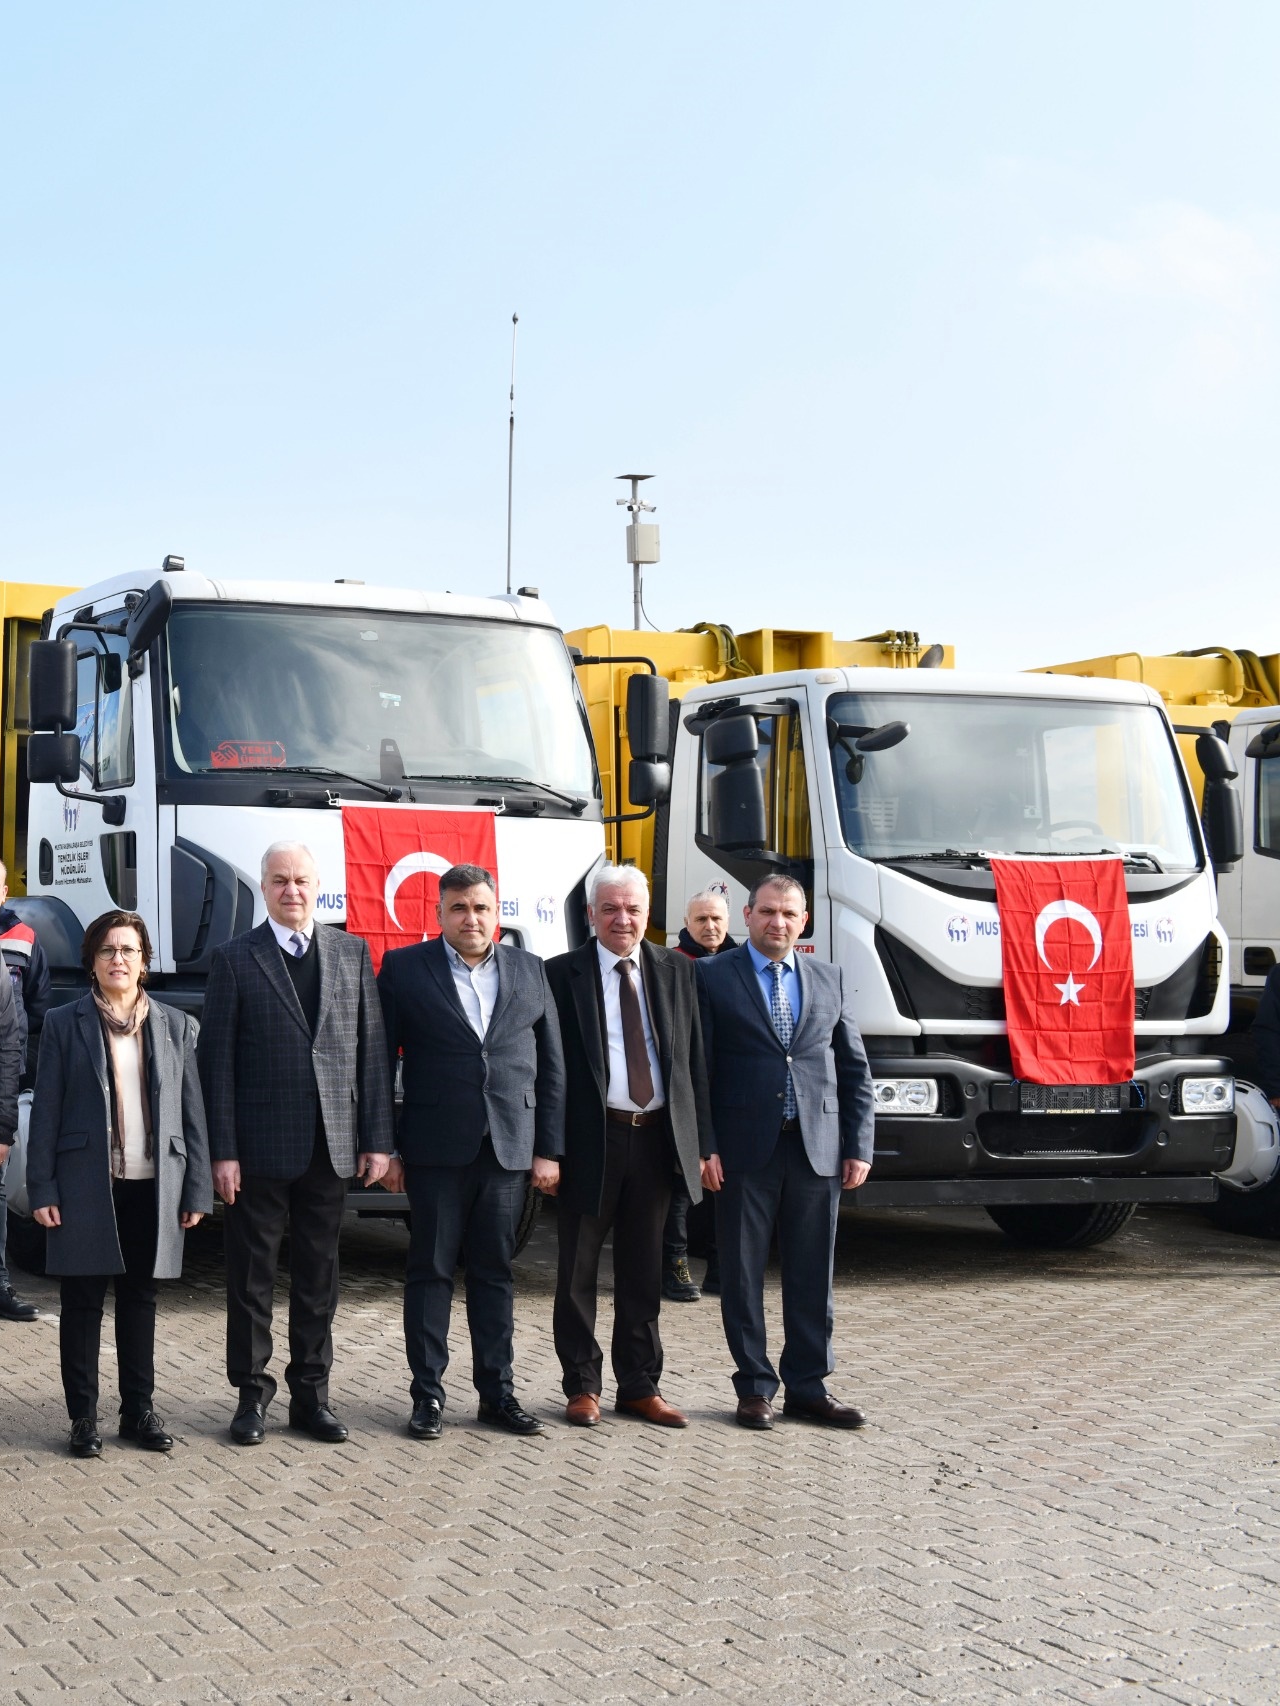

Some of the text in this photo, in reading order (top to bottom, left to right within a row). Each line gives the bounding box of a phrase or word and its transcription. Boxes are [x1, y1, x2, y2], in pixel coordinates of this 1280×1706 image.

[240, 745, 272, 754] YERLİ
[240, 755, 280, 764] ÜRETİM
[57, 851, 76, 863] TEMİZLİK
[60, 862, 86, 875] MÜDÜRLÜĞÜ
[500, 897, 519, 917] ESİ
[975, 921, 1000, 936] MUS
[1131, 920, 1149, 938] ESİ
